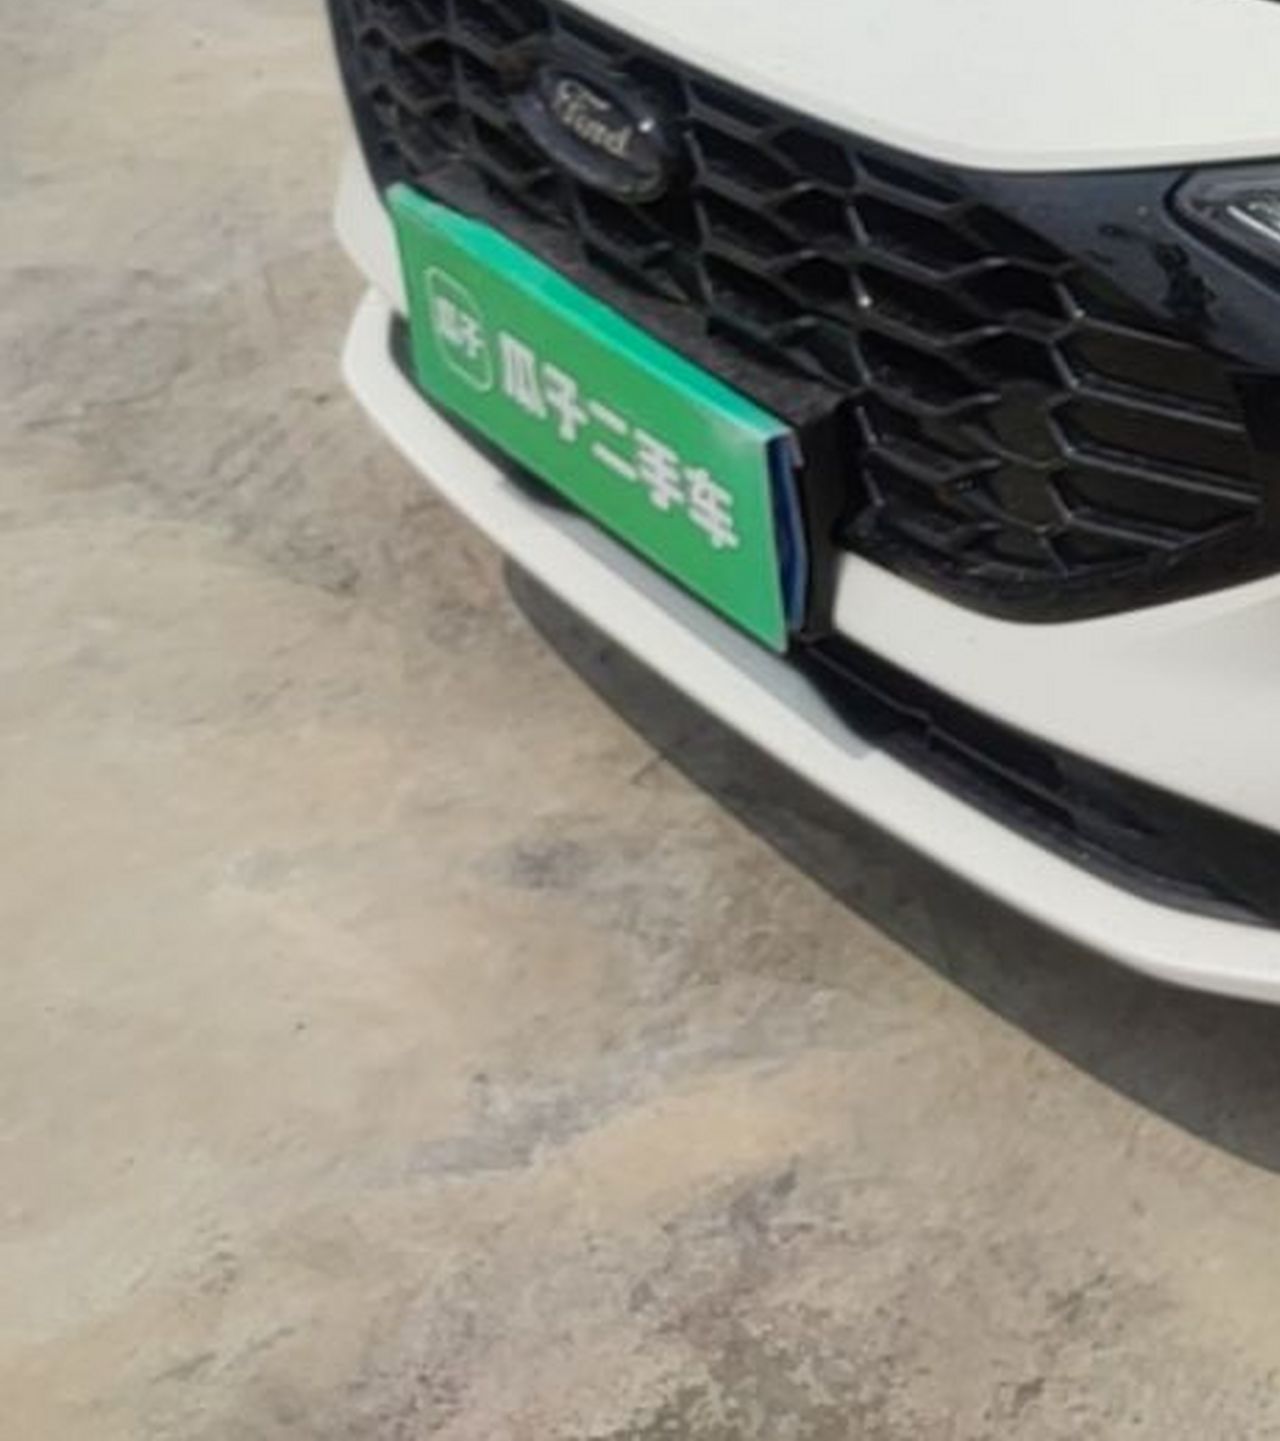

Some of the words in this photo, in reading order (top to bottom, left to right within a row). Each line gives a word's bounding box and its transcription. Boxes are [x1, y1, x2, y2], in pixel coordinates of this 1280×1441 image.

[551, 80, 633, 159] Ford
[498, 330, 741, 550] 瓜子二手车
